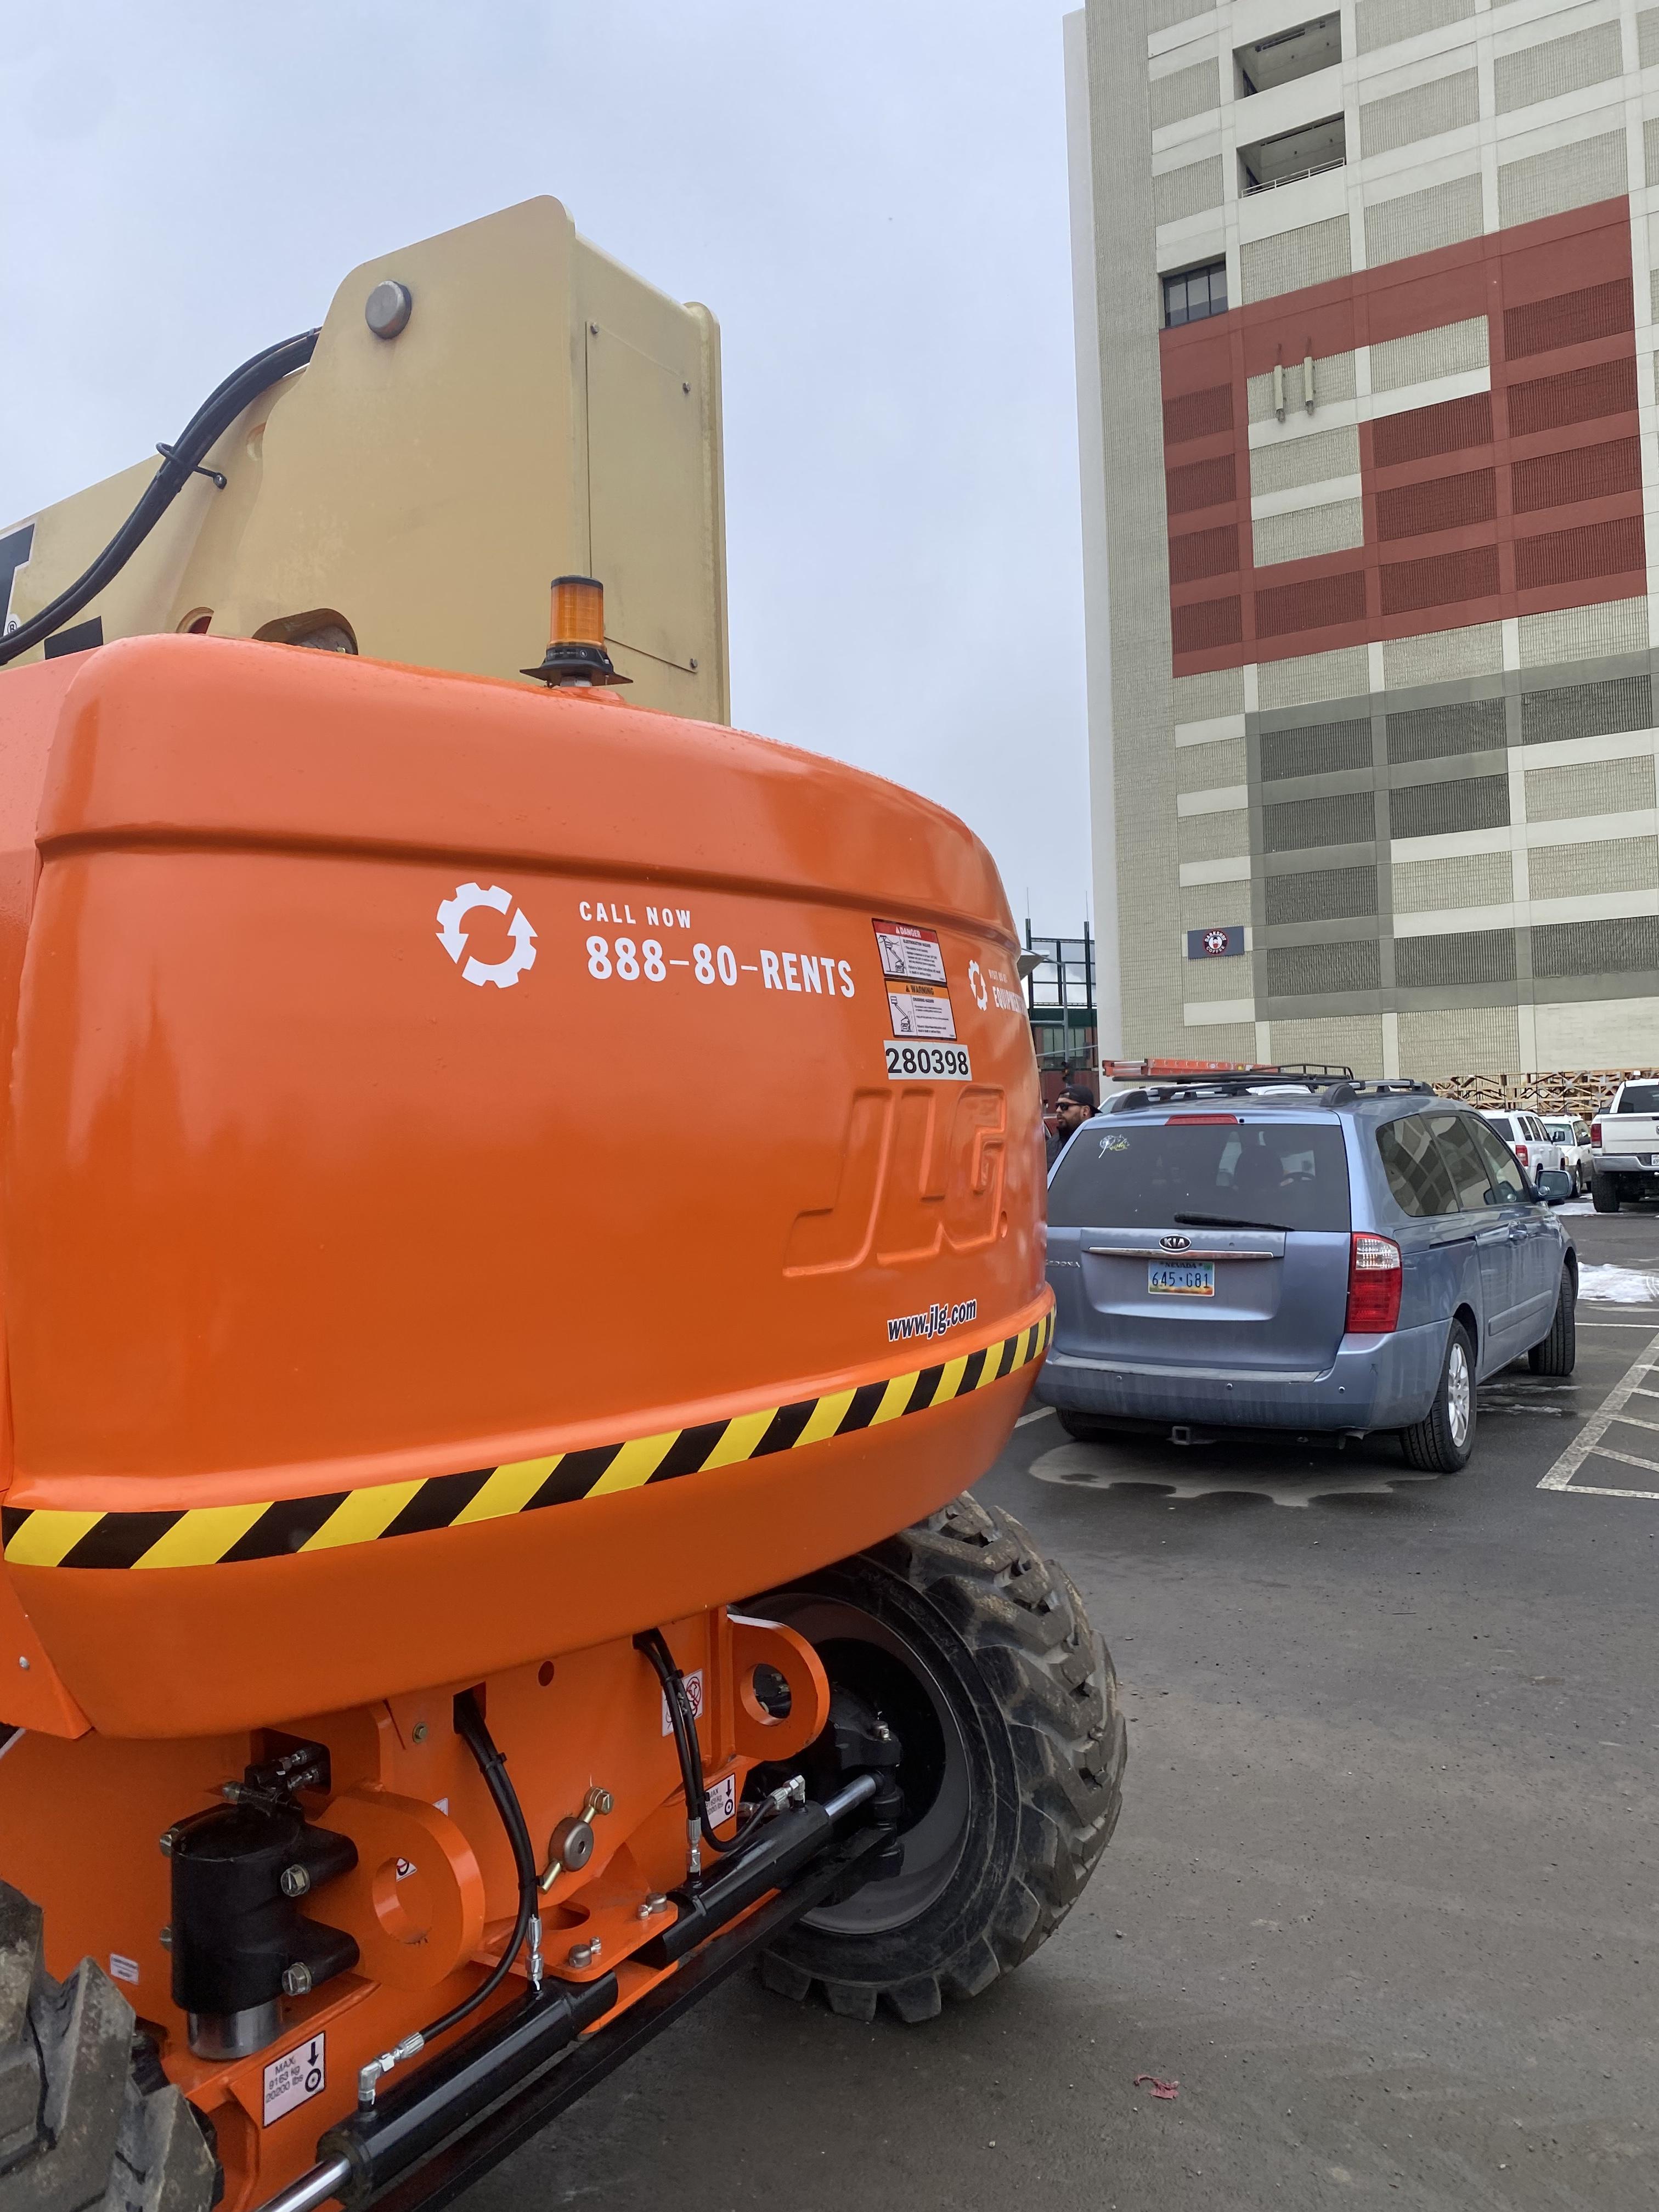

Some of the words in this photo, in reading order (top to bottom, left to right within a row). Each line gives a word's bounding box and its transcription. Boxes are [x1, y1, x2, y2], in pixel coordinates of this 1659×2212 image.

[579, 901, 637, 926] CALL
[647, 906, 692, 929] NOW
[900, 927, 922, 938] DANGER
[1204, 931, 1227, 942] DARKSHOT
[1206, 945, 1225, 953] COFFEE
[585, 935, 856, 998] 888-80-RENTS
[911, 985, 934, 995] WARNING
[885, 1048, 969, 1075] 280398
[1164, 1235, 1186, 1247] KIA
[888, 1299, 977, 1342] www.jlg.com
[275, 2056, 296, 2075] MAX
